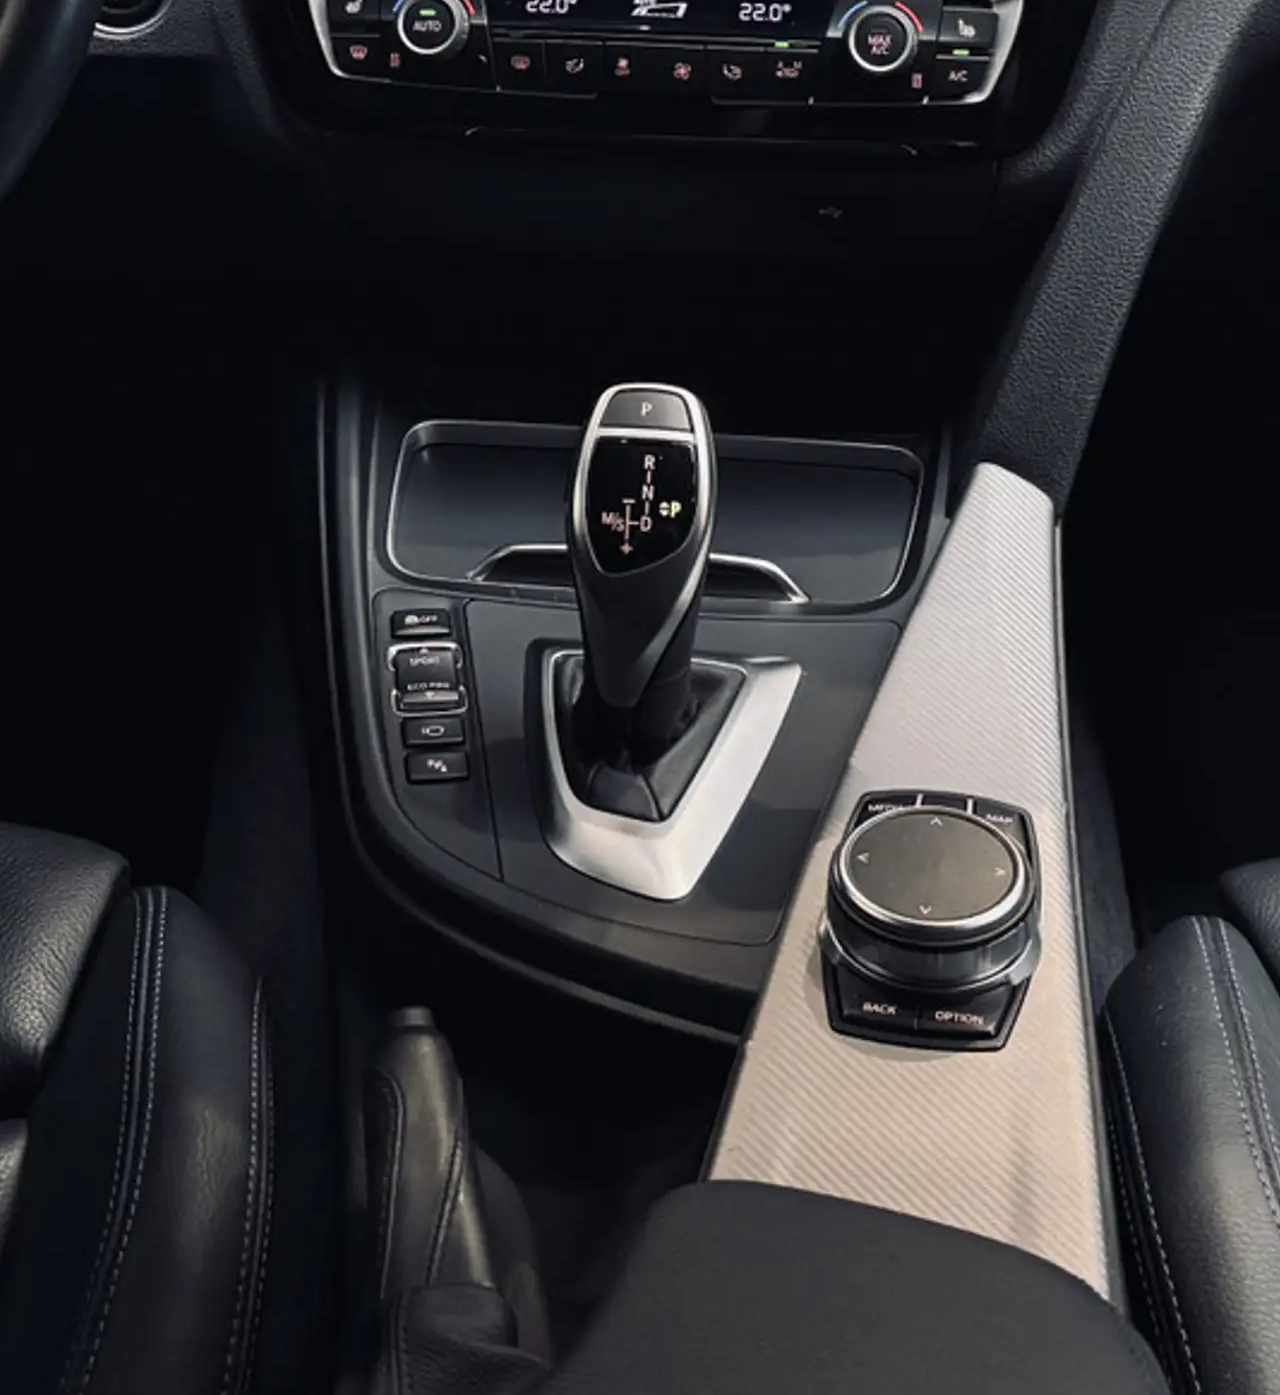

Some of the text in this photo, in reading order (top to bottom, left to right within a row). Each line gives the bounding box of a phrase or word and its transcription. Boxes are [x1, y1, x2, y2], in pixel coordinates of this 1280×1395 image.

[412, 19, 442, 32] AUTO
[868, 33, 893, 47] MAX
[948, 69, 969, 83] A/C
[641, 401, 653, 417] P
[644, 454, 656, 470] R
[642, 484, 655, 500] N
[639, 516, 652, 532] D
[985, 813, 1014, 824] MAP
[862, 1002, 898, 1015] BACK
[934, 1009, 985, 1026] OPTION
